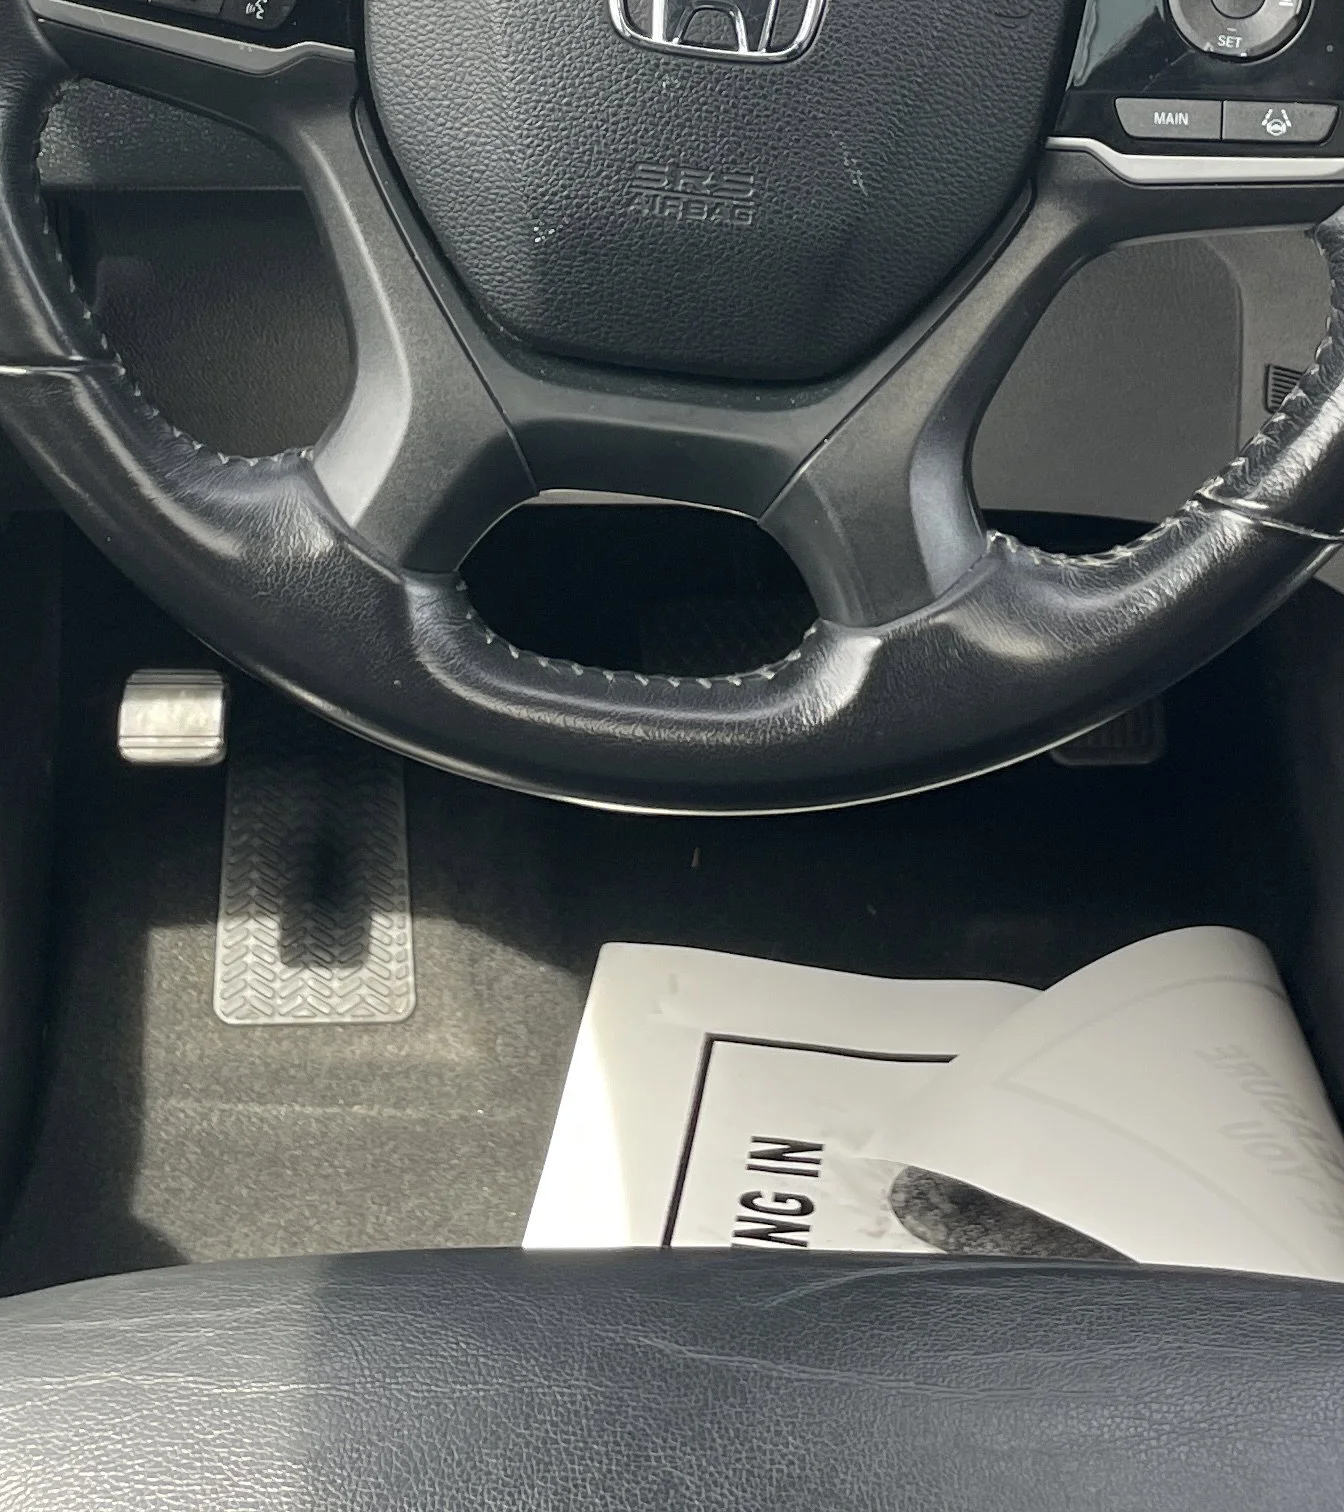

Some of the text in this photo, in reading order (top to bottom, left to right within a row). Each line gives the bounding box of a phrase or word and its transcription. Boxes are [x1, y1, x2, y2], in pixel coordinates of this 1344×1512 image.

[1218, 34, 1243, 49] SET
[1153, 111, 1189, 127] MAIN
[731, 1135, 826, 1248] NG IN
